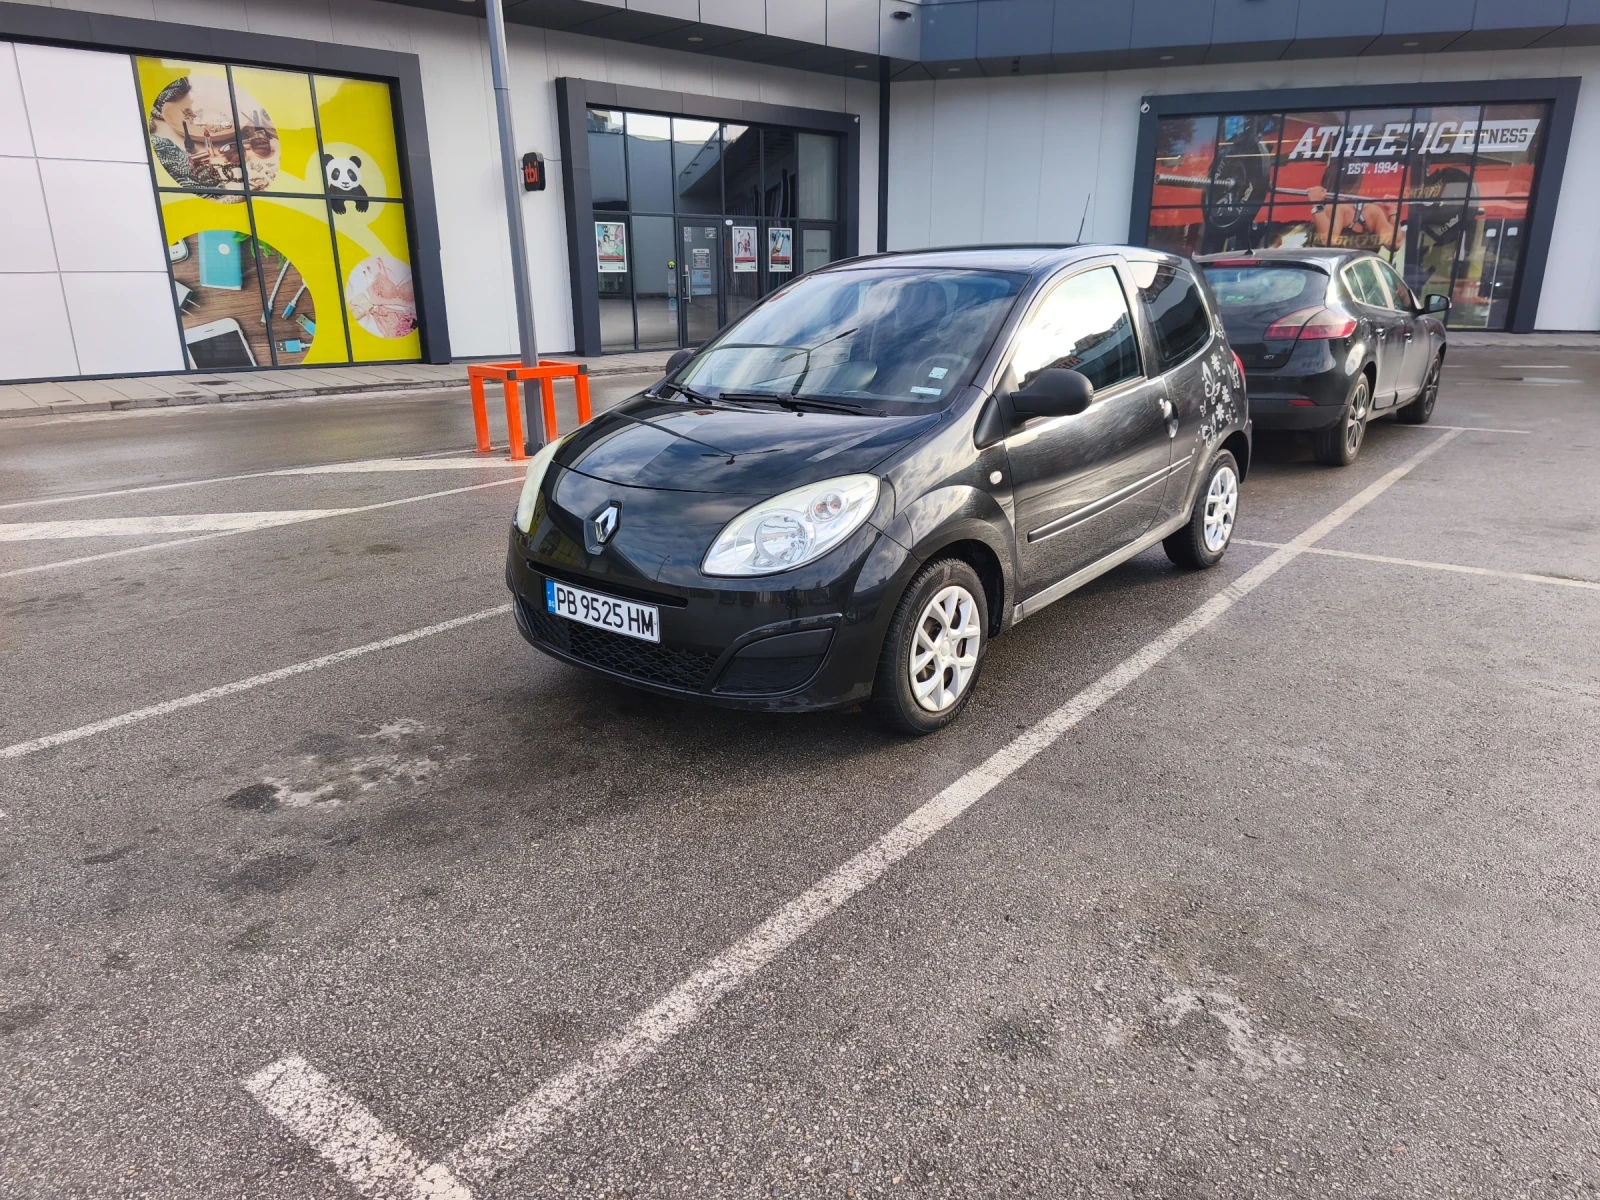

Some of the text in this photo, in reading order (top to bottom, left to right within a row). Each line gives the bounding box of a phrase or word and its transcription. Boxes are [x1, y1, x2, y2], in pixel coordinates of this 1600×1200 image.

[1288, 121, 1459, 160] ATHLETIC
[1346, 161, 1399, 175] EST. 1994
[556, 587, 654, 637] PB 9525 HM
